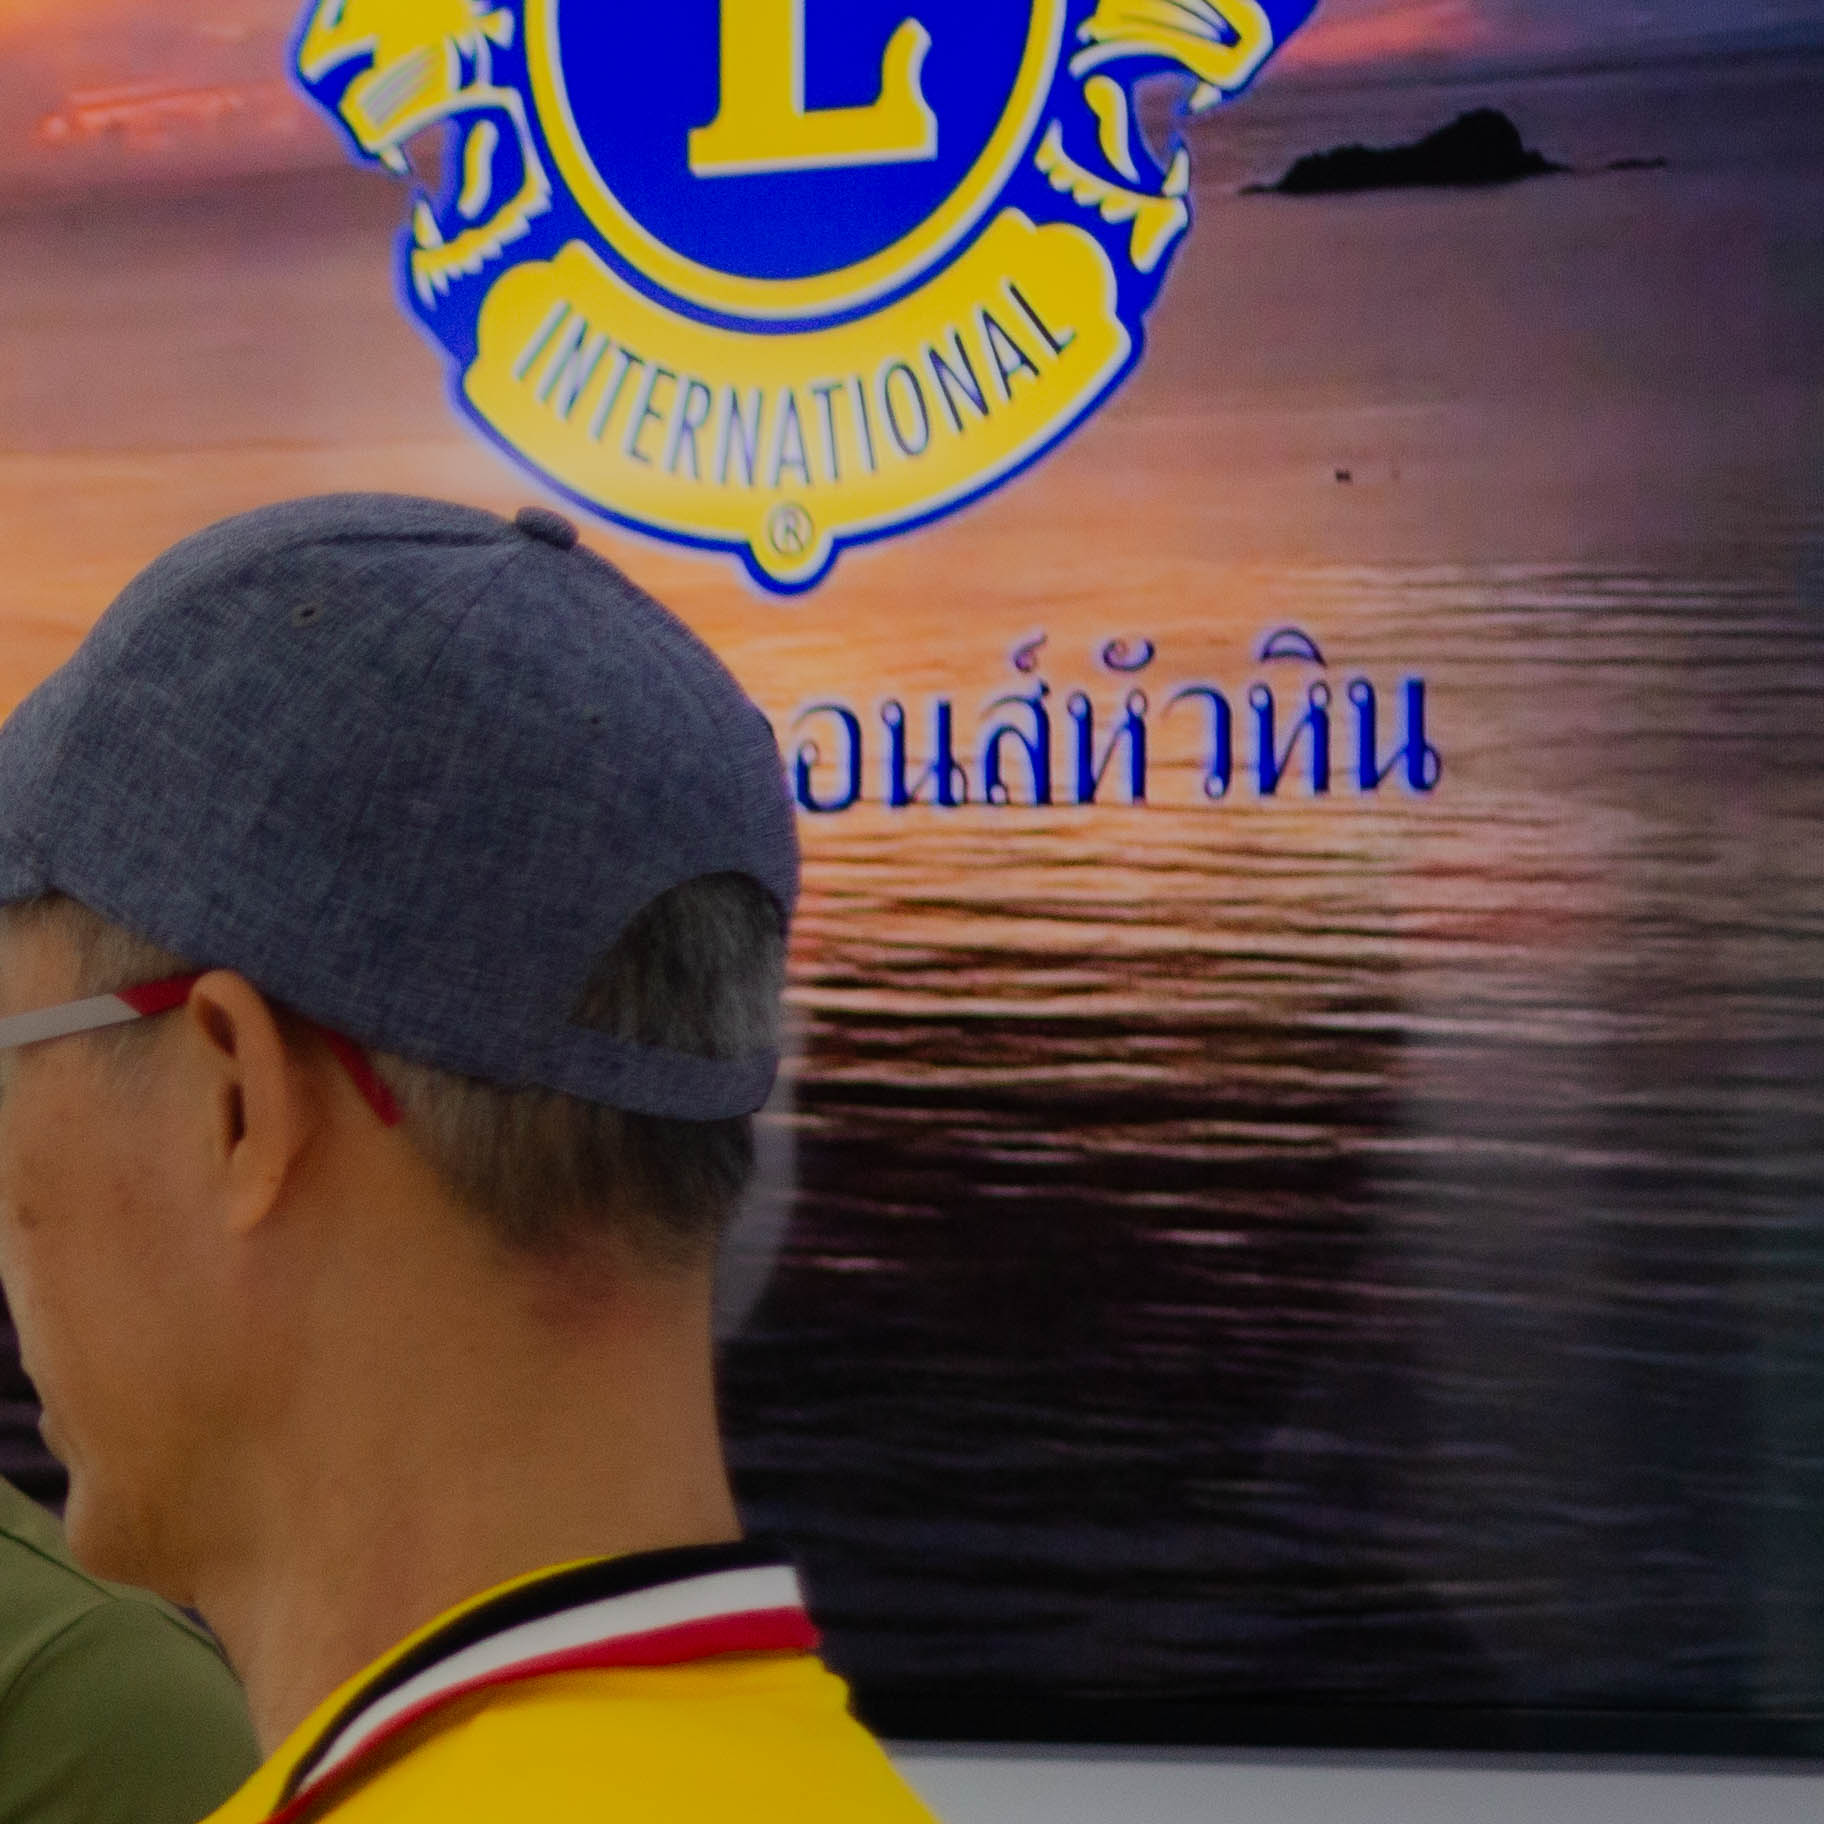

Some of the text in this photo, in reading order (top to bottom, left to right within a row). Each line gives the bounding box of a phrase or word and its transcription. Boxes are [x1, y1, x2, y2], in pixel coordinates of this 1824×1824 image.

[514, 281, 1076, 488] INTERNATIONAL
[790, 626, 1443, 814] อนส์หัวหิน
